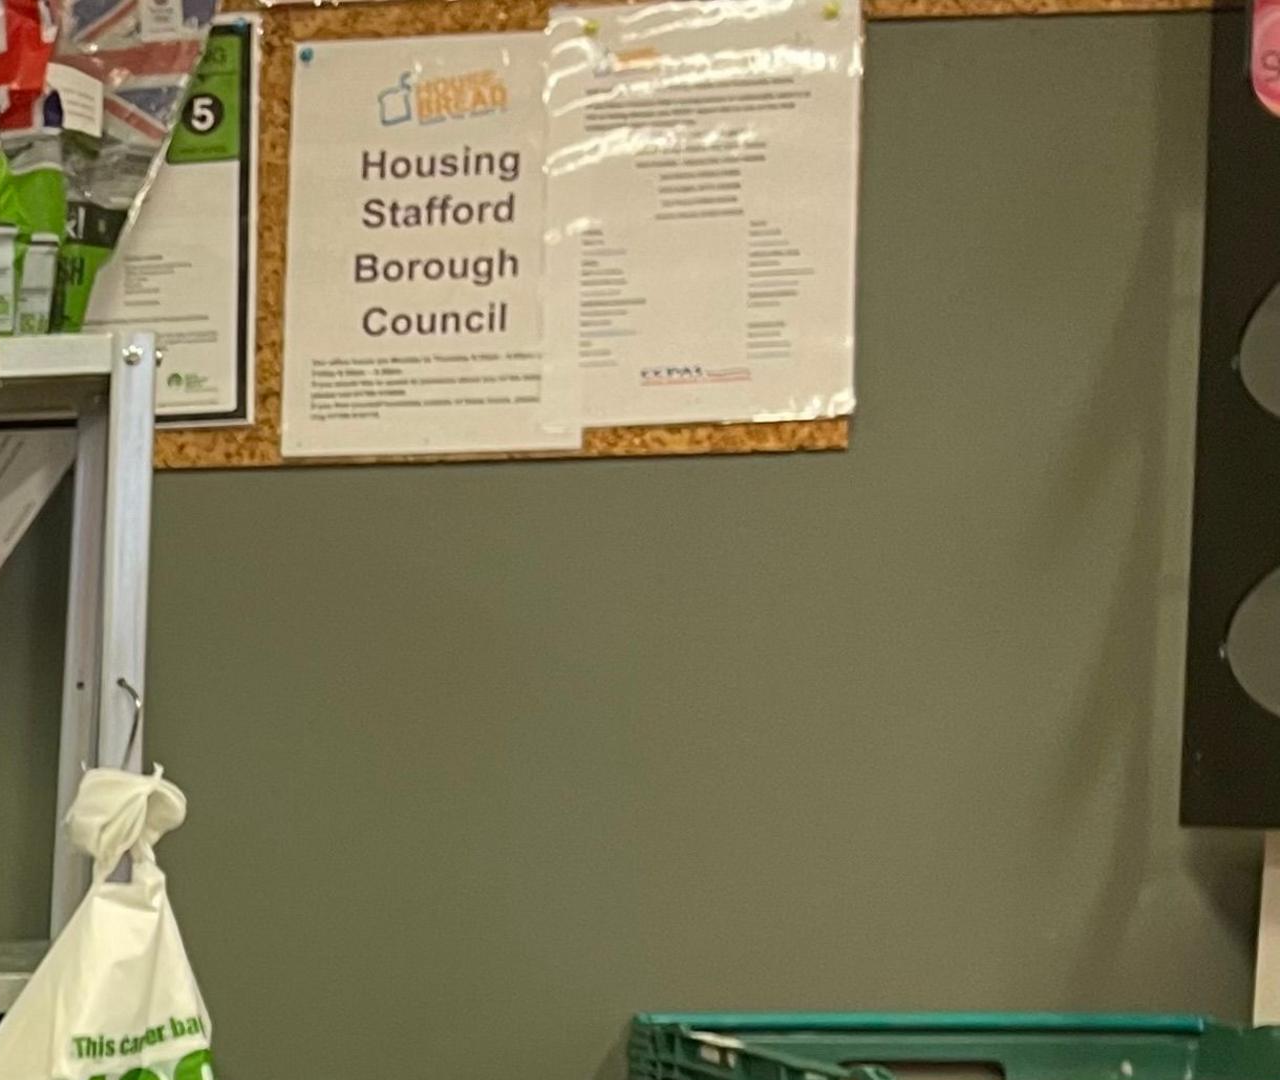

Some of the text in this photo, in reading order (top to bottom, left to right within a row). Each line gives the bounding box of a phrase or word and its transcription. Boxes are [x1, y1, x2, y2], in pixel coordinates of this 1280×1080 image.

[191, 96, 215, 131] 5
[361, 145, 520, 182] Housing
[362, 192, 515, 229] Stafford
[354, 248, 519, 286] Borough
[362, 302, 507, 336] Council
[72, 1035, 115, 1059] This
[170, 1014, 206, 1040] ba
